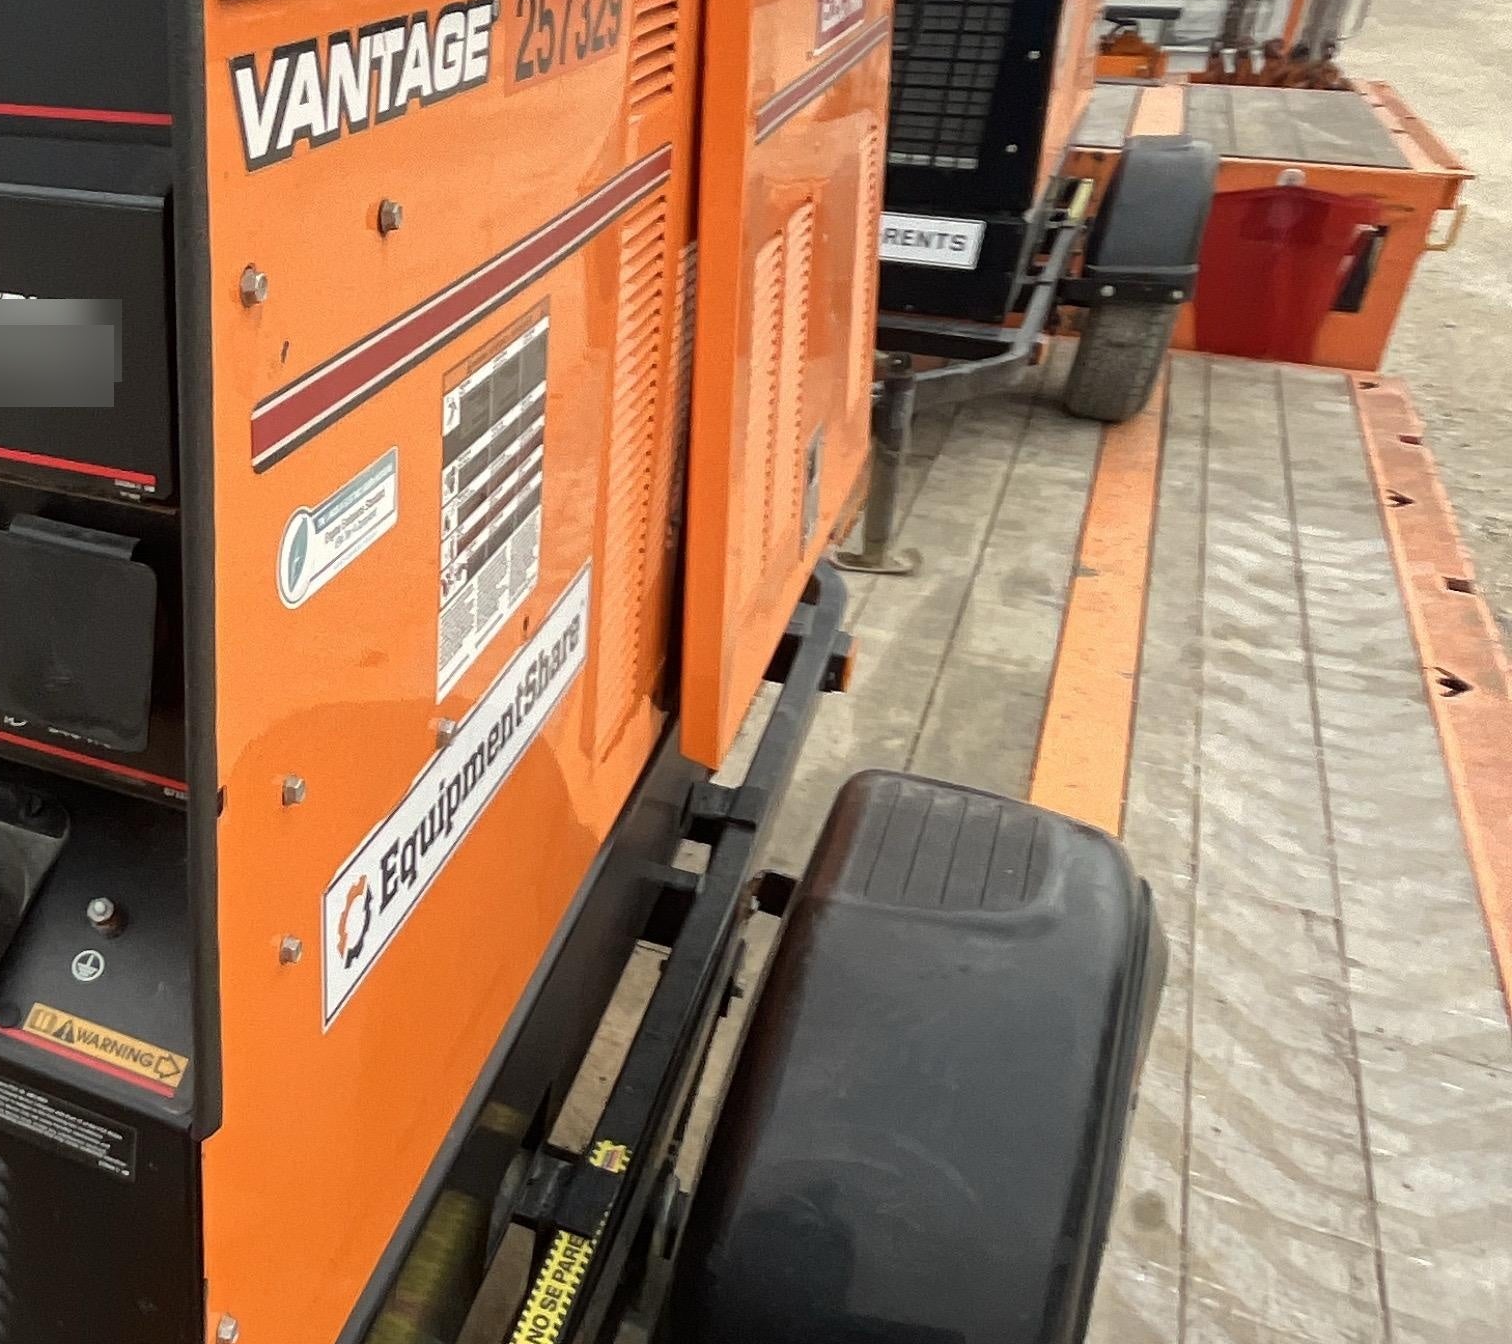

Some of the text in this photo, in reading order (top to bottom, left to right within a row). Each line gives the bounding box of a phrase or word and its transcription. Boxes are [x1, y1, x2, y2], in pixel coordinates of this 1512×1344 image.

[882, 227, 968, 252] RENTS
[378, 613, 582, 915] EquipmentShare
[76, 1029, 154, 1069] WARNING
[538, 1280, 564, 1314] SE
[552, 1233, 586, 1285] PARE
